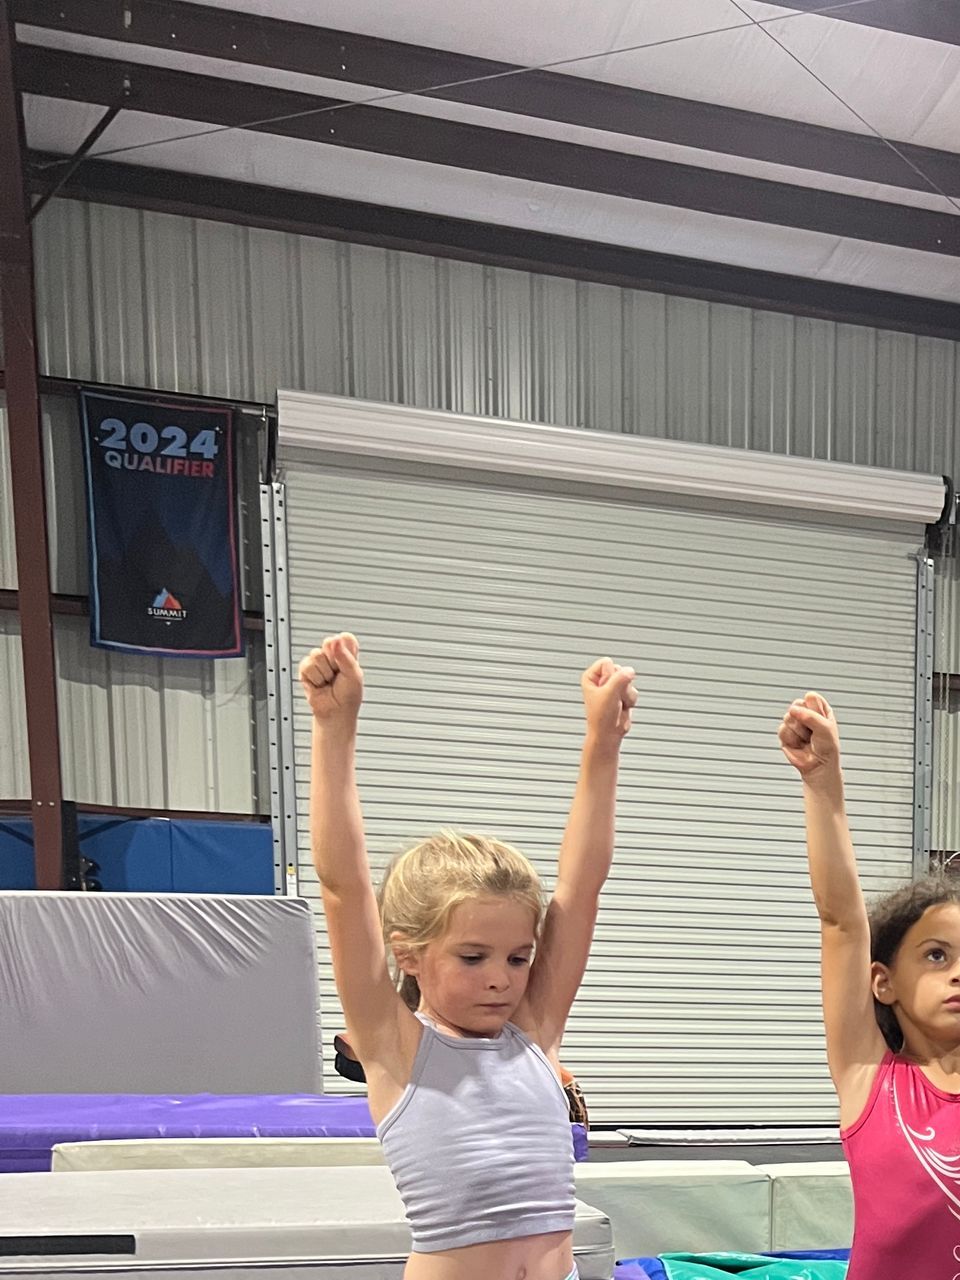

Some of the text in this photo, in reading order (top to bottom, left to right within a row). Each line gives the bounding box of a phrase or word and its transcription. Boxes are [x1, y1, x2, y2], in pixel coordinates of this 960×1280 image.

[100, 418, 218, 459] 2024
[104, 451, 214, 477] QUALIFIER
[148, 607, 187, 618] SUMMIT
